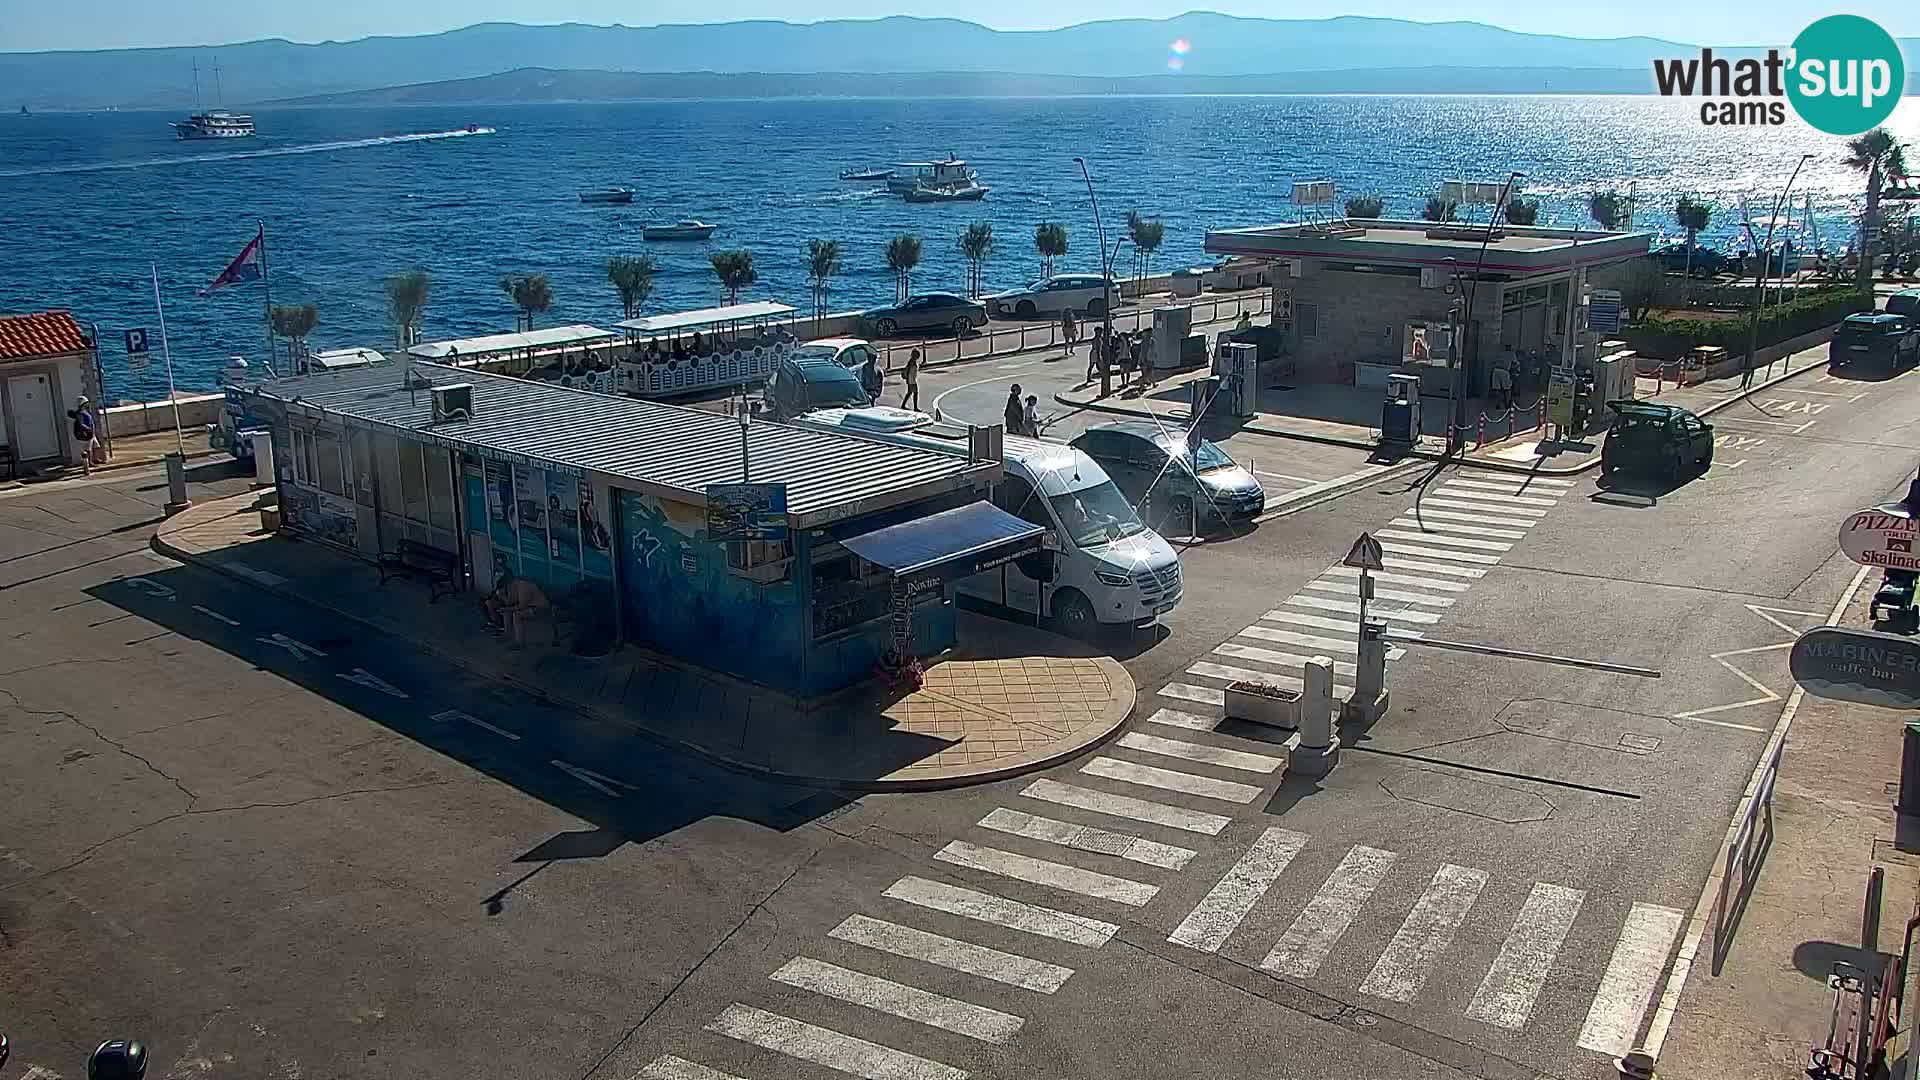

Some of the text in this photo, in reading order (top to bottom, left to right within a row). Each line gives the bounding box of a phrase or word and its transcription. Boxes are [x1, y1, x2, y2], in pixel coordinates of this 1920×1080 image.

[129, 331, 142, 350] P
[1759, 399, 1831, 414] TAXI
[1714, 435, 1766, 451] AXI
[494, 451, 526, 465] STATION
[529, 457, 554, 471] TICKET
[556, 463, 584, 477] OFFICE
[1849, 516, 1920, 533] PIZZE
[1872, 666, 1896, 681] bar
